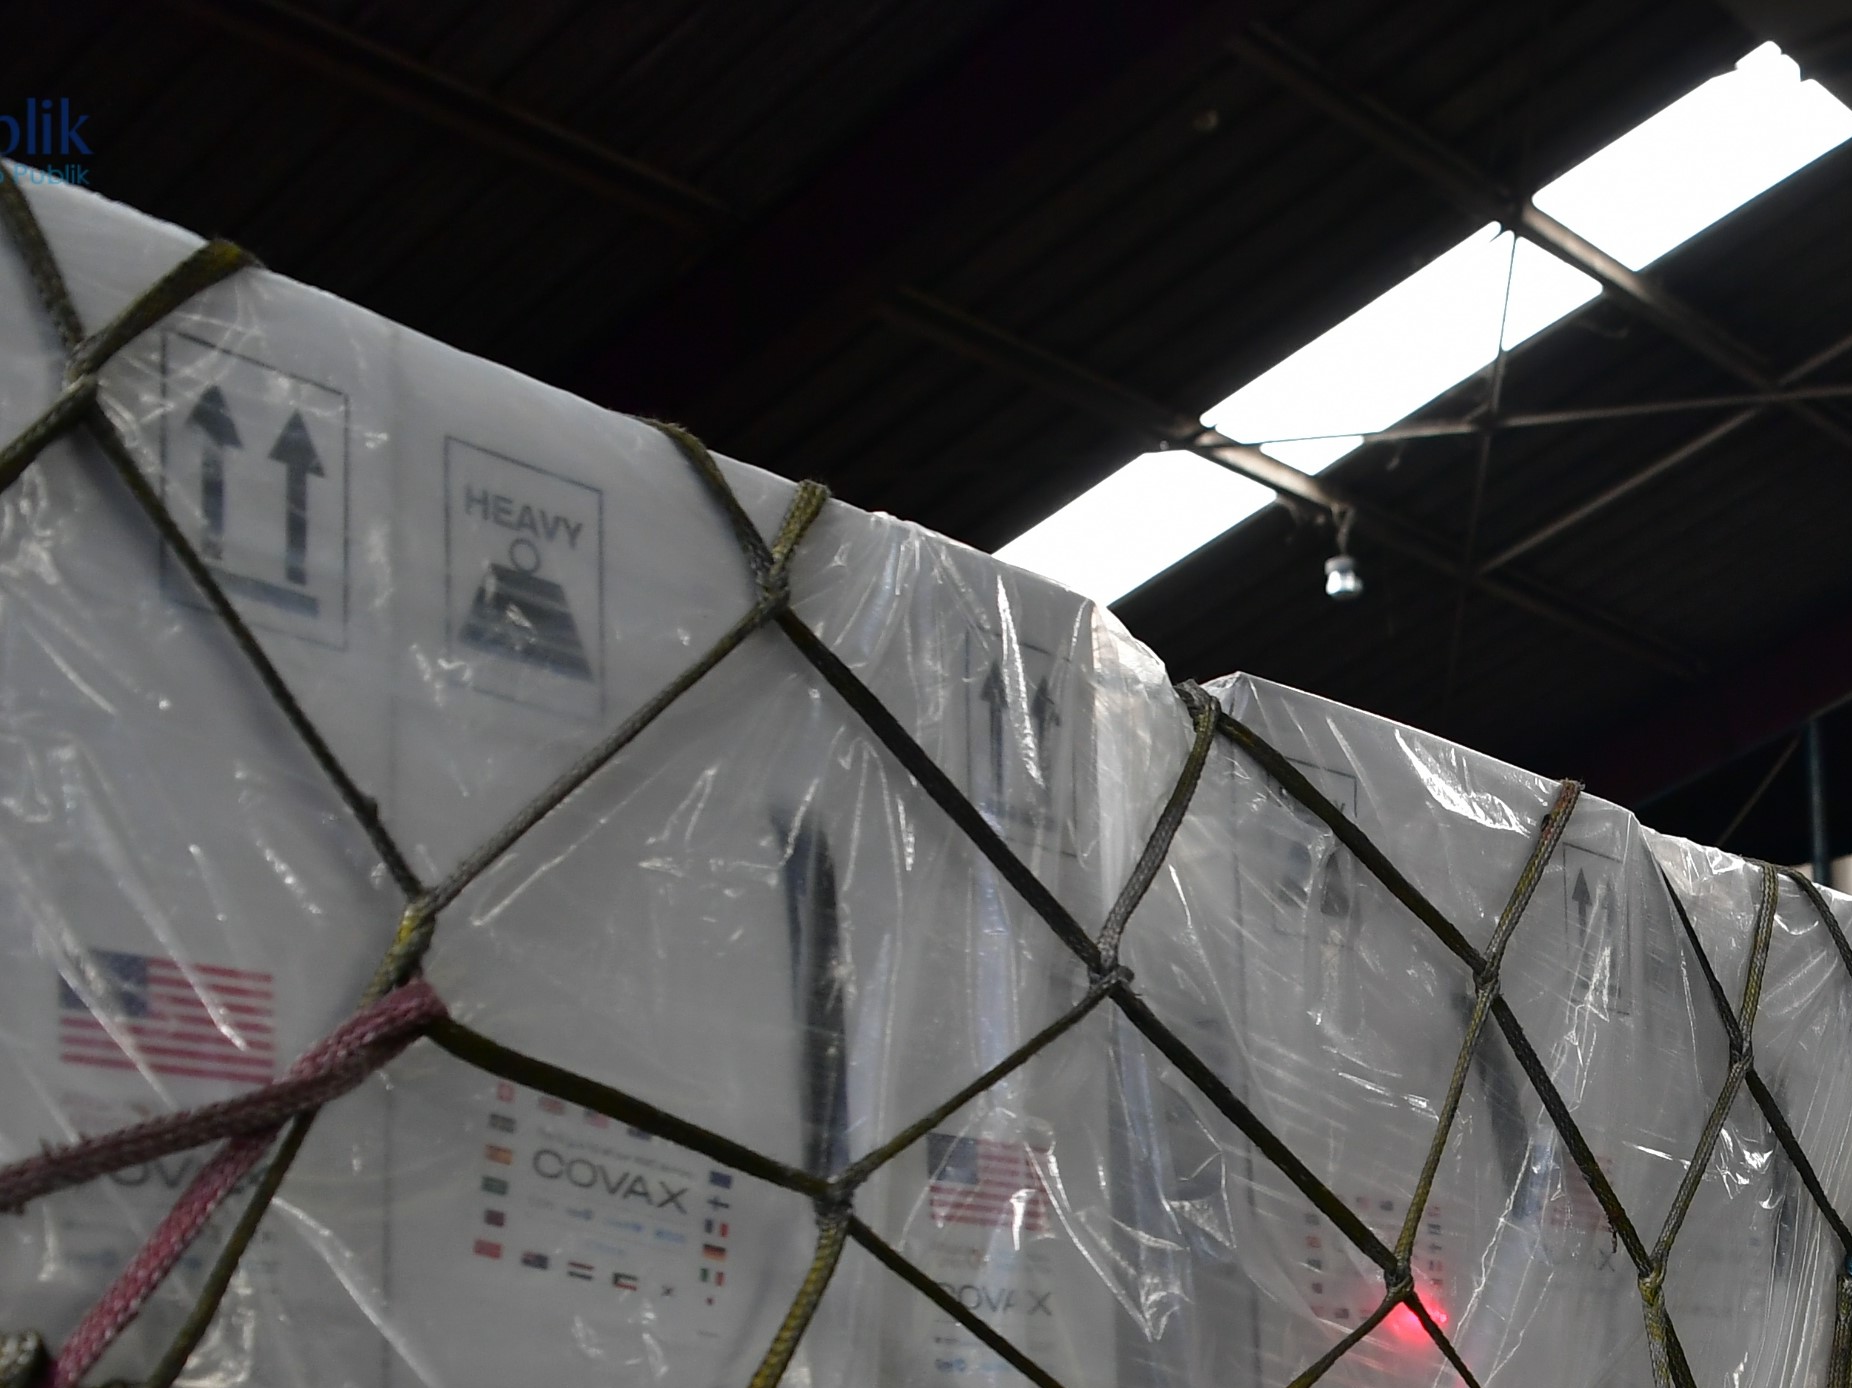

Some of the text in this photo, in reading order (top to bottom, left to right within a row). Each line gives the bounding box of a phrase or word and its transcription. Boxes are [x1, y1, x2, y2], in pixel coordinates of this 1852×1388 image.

[463, 482, 583, 550] HEAVY
[532, 1148, 688, 1215] COVAX
[936, 1281, 1053, 1316] OVAX
